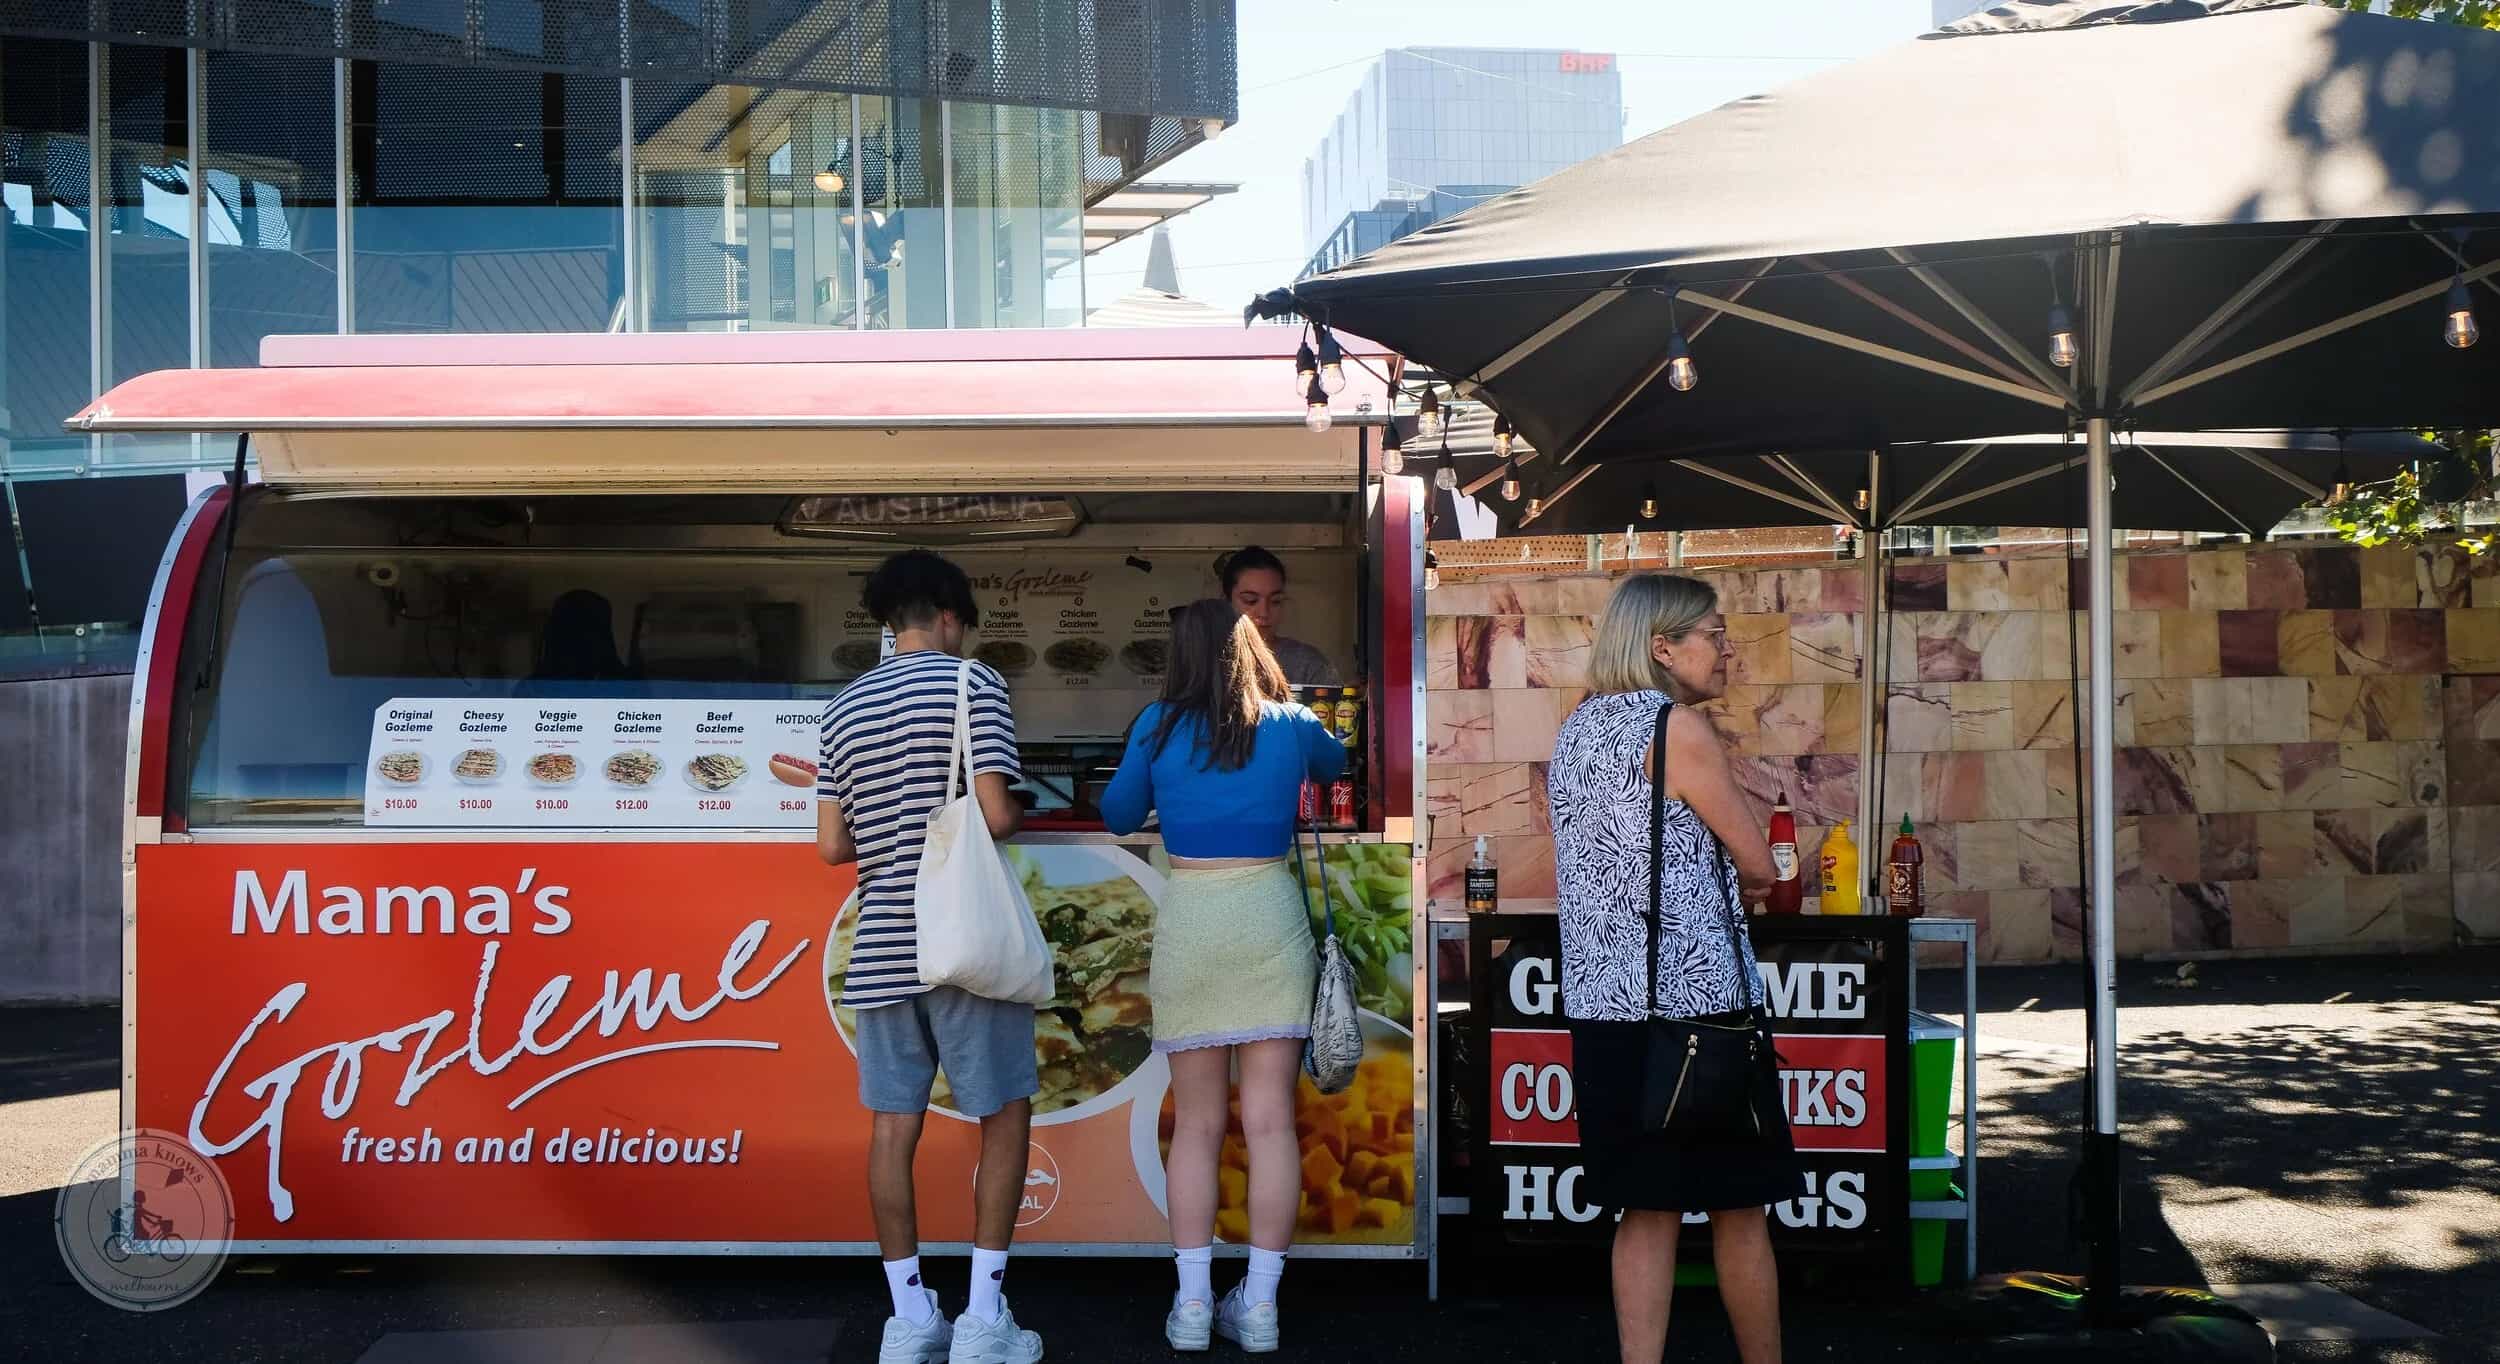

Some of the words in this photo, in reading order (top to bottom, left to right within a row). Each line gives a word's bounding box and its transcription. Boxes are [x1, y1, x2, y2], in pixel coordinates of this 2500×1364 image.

[1061, 609, 1097, 618] Chicken
[1144, 609, 1165, 618] Beef
[1134, 620, 1169, 629] Gozlem
[389, 709, 433, 722] Original
[463, 710, 505, 722] Cheesy
[539, 710, 577, 721] Veggie
[617, 711, 662, 721] Chicken
[706, 711, 733, 721] Beef
[385, 722, 433, 732] Gozleme
[459, 723, 508, 733] Gozleme
[535, 723, 583, 733] Gozleme
[614, 723, 663, 734] Gozleme
[696, 724, 745, 734] Gozleme
[385, 799, 418, 809] $10.00
[459, 799, 492, 809] $10.00
[535, 800, 569, 810] $10.00
[615, 800, 648, 810] $12.00
[698, 800, 731, 810] $12.00
[779, 800, 807, 811] $6.00
[230, 867, 573, 936] Mama's
[188, 919, 811, 1223] Gozleme
[341, 1127, 442, 1165] fresh
[454, 1128, 533, 1165] and
[544, 1128, 744, 1165] delicious!
